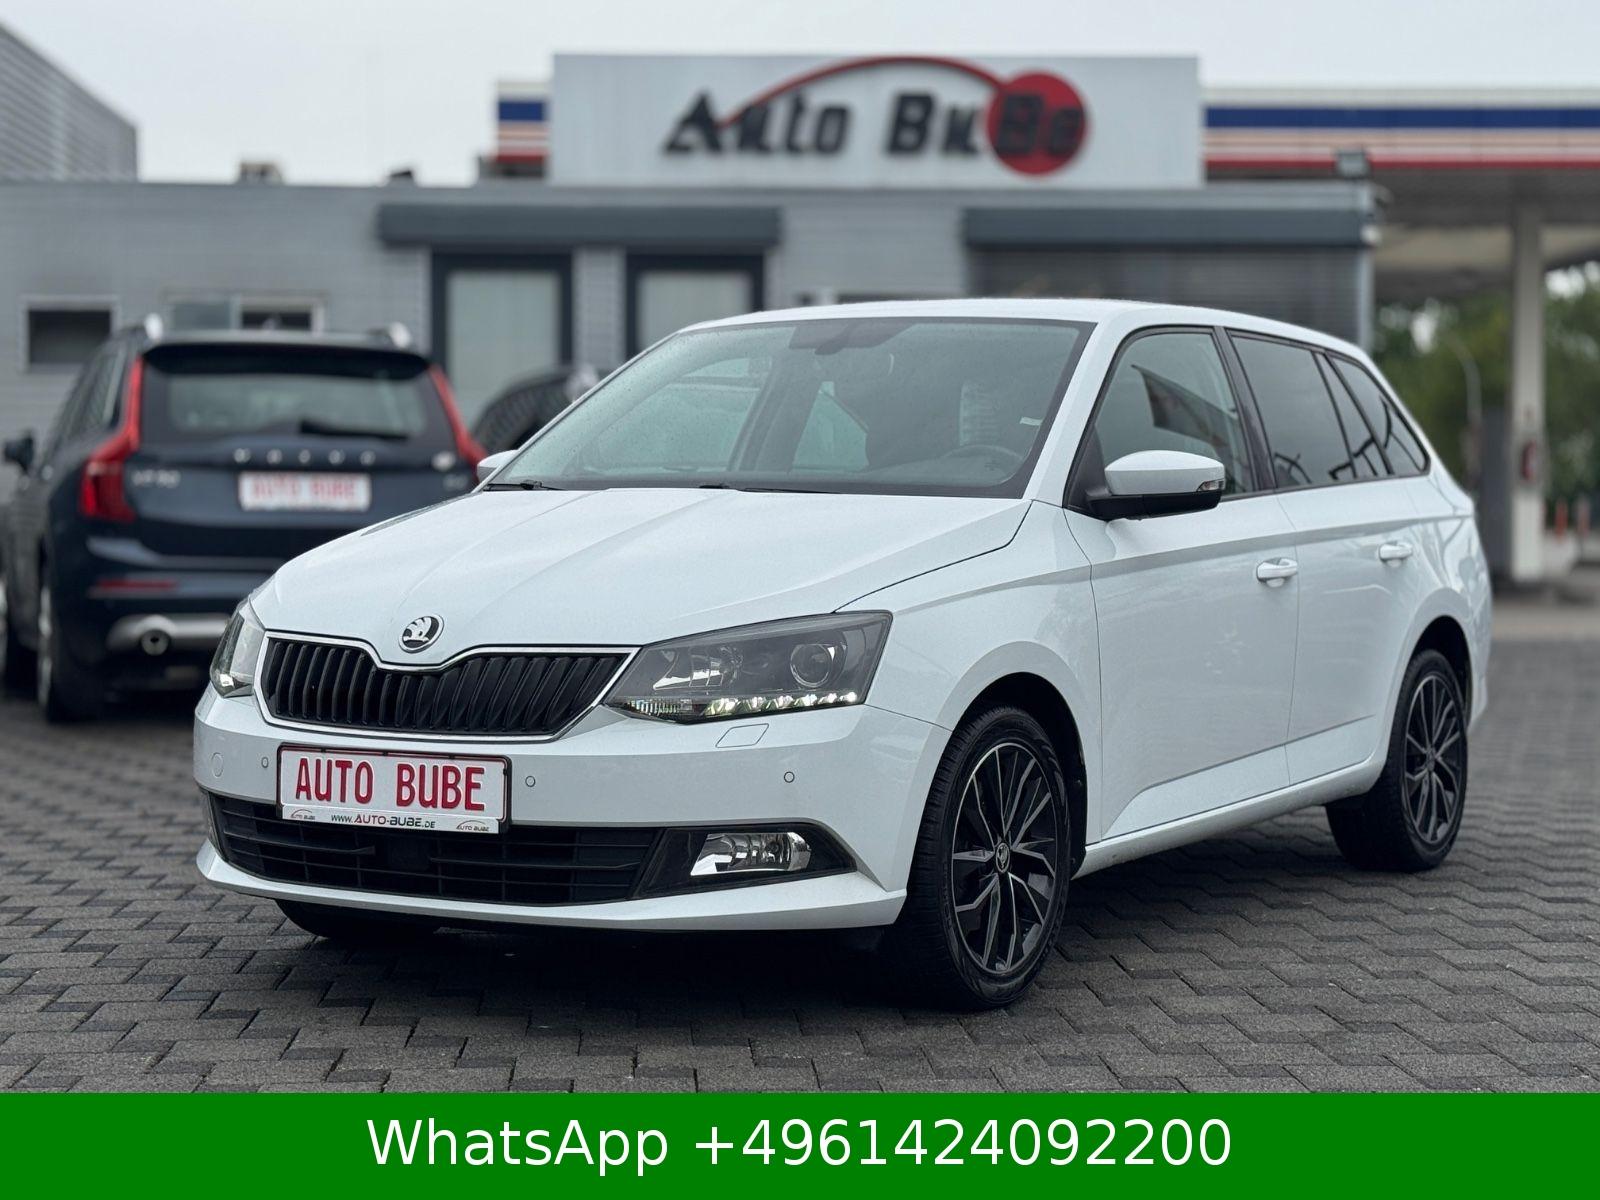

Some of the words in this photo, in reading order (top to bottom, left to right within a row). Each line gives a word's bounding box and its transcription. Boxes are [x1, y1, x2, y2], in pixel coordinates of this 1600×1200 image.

[664, 88, 849, 155] Auto
[295, 758, 374, 804] AUTO
[396, 763, 485, 811] BUBE
